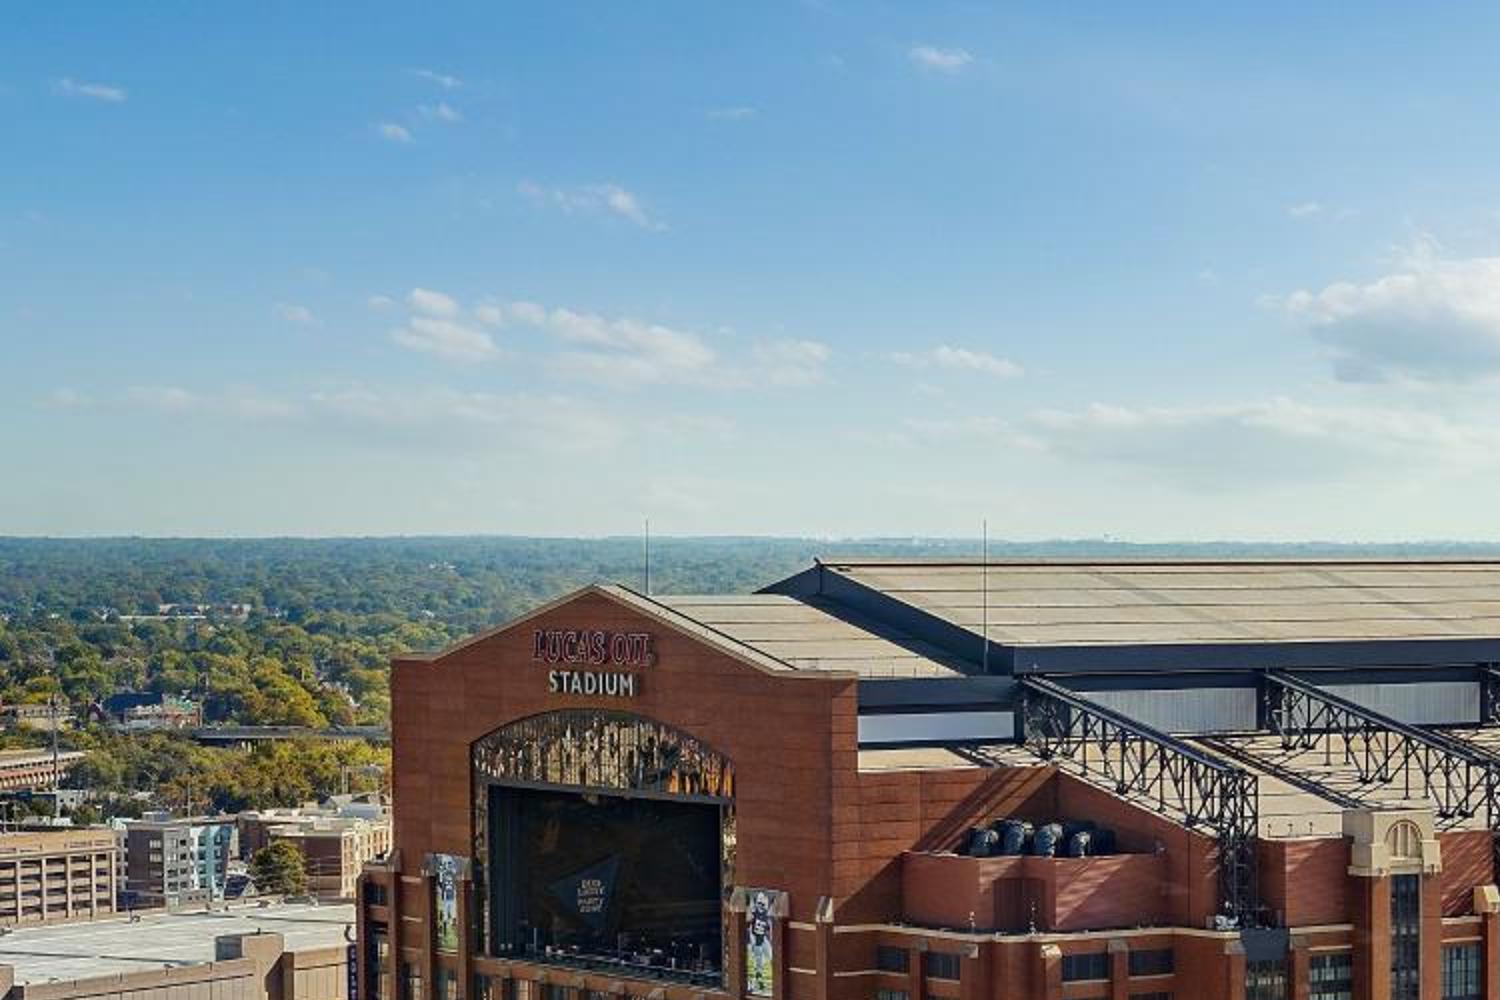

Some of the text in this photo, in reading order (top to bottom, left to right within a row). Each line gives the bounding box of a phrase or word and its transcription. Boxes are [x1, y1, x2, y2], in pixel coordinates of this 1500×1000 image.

[532, 629, 654, 667] LUCAS OIL
[549, 669, 634, 698] STADIUM
